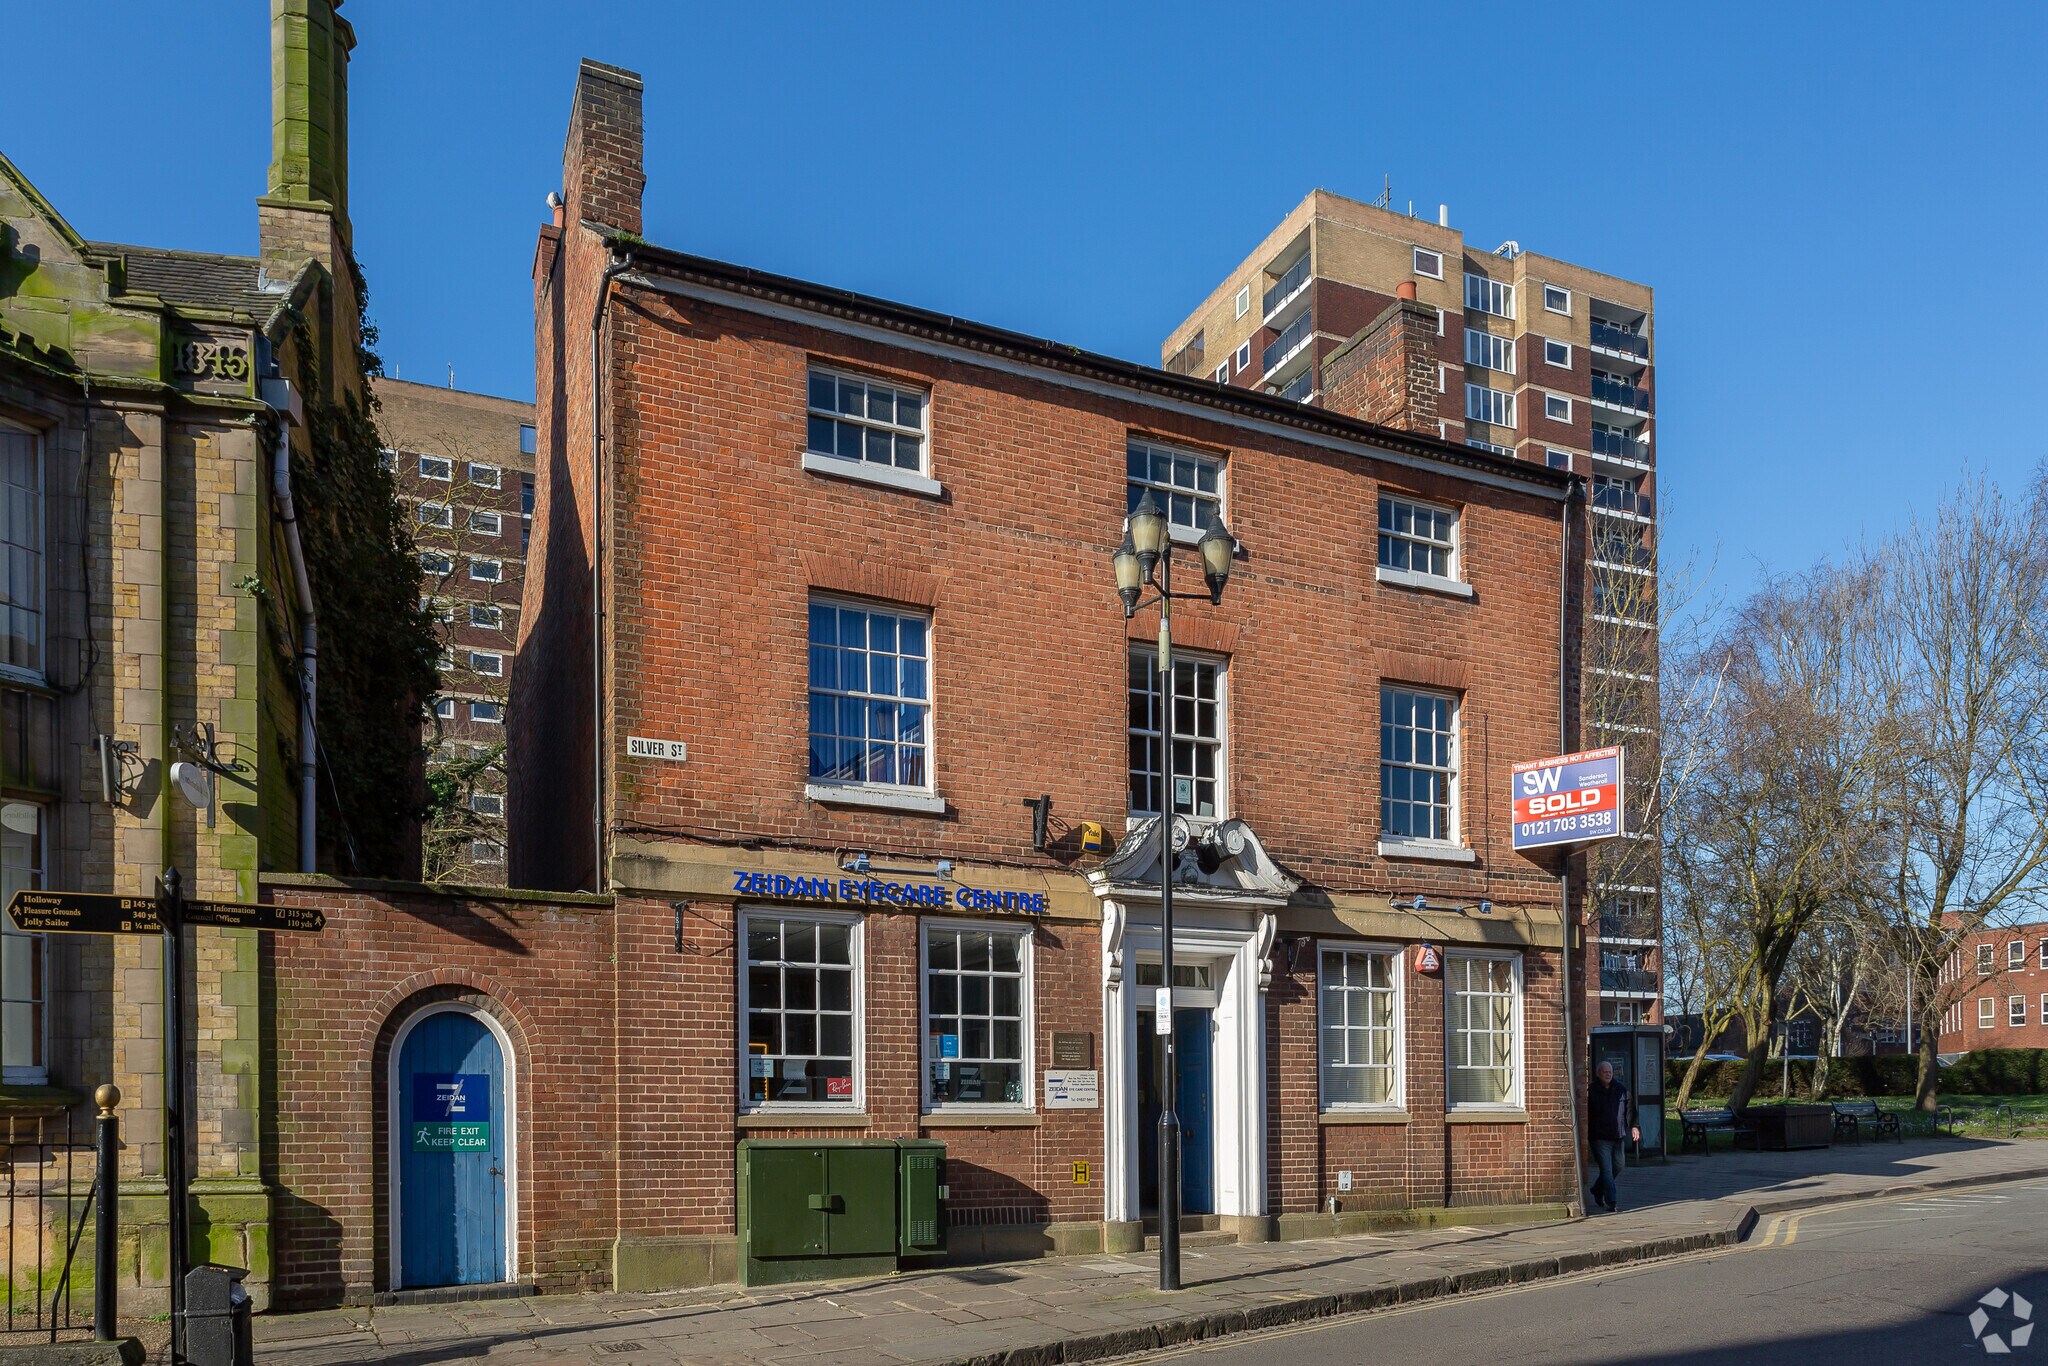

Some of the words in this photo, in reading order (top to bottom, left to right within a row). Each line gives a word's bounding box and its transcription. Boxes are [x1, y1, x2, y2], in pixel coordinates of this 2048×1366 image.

[632, 740, 664, 756] SILVER
[1514, 762, 1537, 771] TENANT
[1539, 757, 1568, 767] BUSINESS
[1570, 754, 1582, 762] NOT
[1584, 748, 1616, 759] AFFECTED
[1523, 766, 1562, 795] SW
[1579, 773, 1607, 782] Sanderson
[1579, 778, 1607, 787] Weatherall
[1528, 788, 1600, 815] SOLD
[1522, 821, 1550, 837] 0121
[1553, 817, 1576, 832] 703
[1579, 812, 1611, 828] 3538
[1589, 827, 1611, 835] sw.co.uk
[1088, 829, 1100, 838] Yale
[733, 871, 829, 897] ZEIDAN
[839, 879, 945, 905] EYECARE
[956, 888, 1044, 913] CENTRE
[24, 895, 62, 905] Holloway
[133, 900, 146, 908] 145
[24, 907, 51, 915] Pleasure
[53, 908, 81, 916] Grounds
[133, 911, 146, 919] 340
[147, 912, 157, 920] yd
[186, 903, 212, 911] Tourist
[213, 904, 256, 914] Information
[301, 911, 313, 919] yds
[24, 918, 43, 927] Jolly
[45, 919, 69, 927] Sailor
[185, 913, 214, 921] Council
[216, 914, 241, 923] Offices
[301, 921, 313, 929] yds
[438, 1127, 457, 1135] FIRE
[461, 1127, 479, 1135] EXIT
[432, 1138, 455, 1146] KEEP
[458, 1138, 486, 1146] CLEAR
[1075, 1164, 1086, 1181] H
